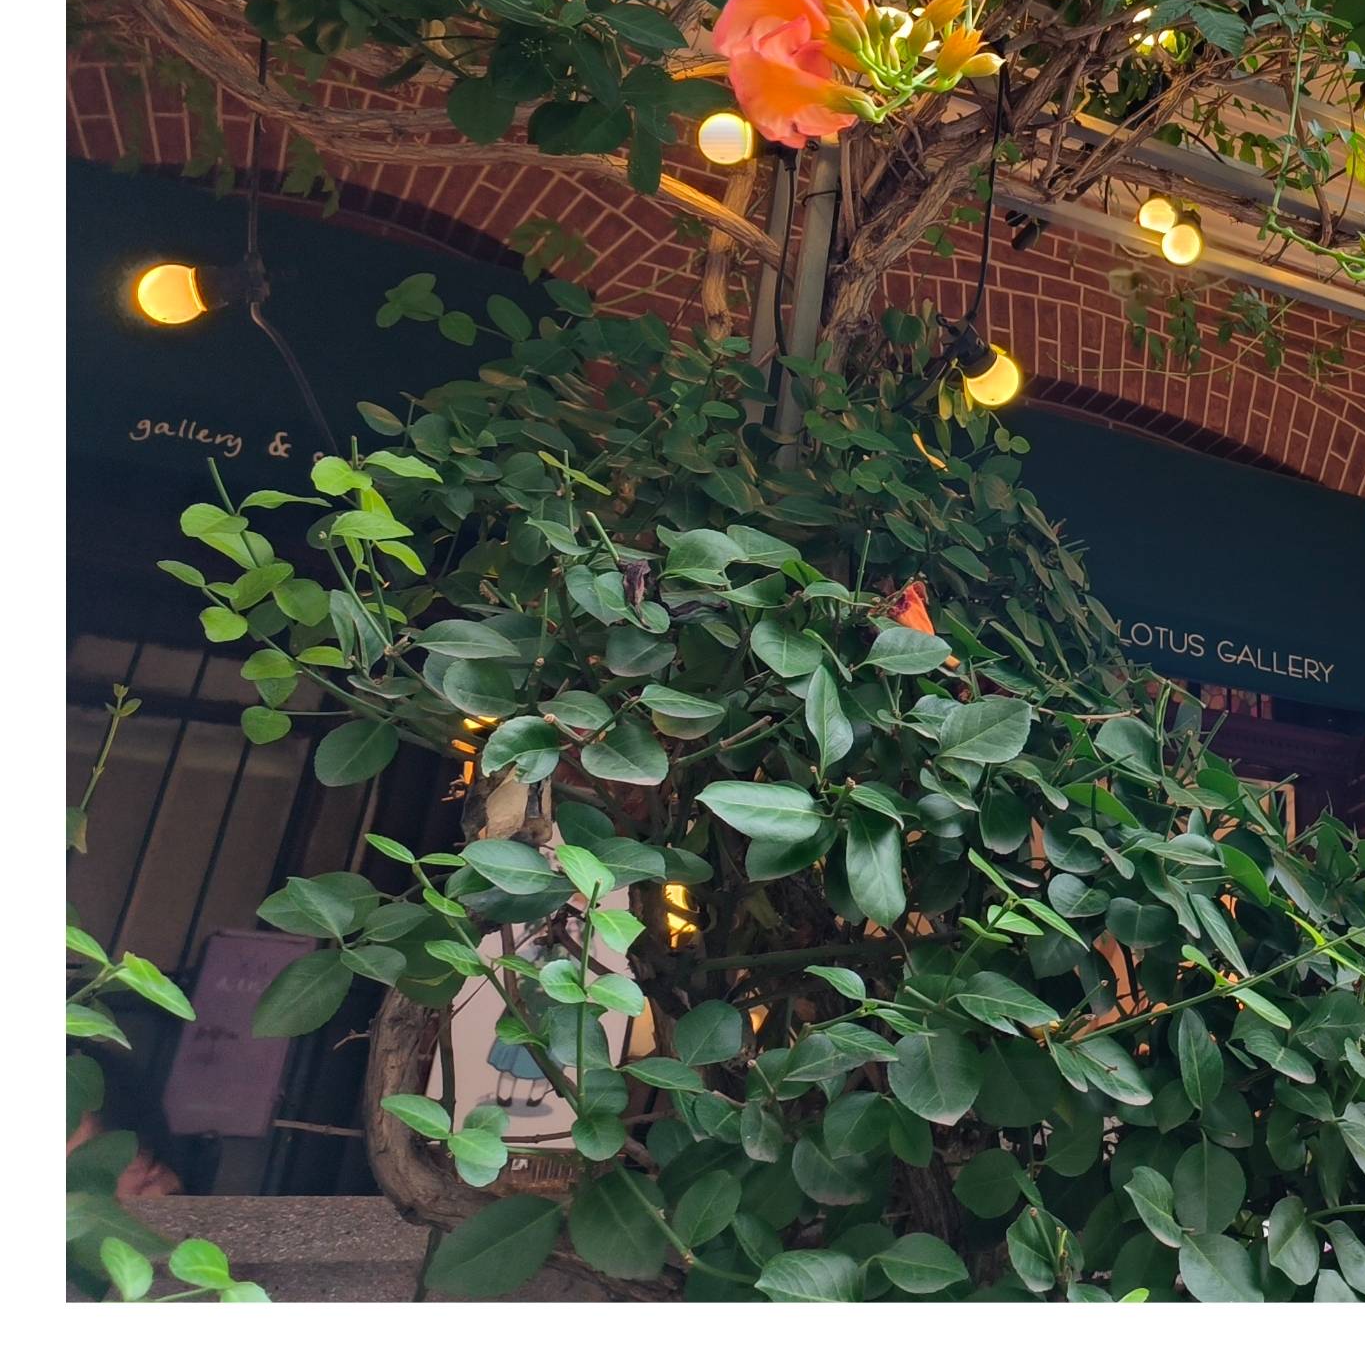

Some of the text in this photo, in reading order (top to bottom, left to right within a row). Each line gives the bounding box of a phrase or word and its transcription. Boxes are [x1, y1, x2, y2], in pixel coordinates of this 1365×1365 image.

[129, 419, 292, 458] gallery &
[1117, 618, 1335, 683] LOTUS GALLERY
